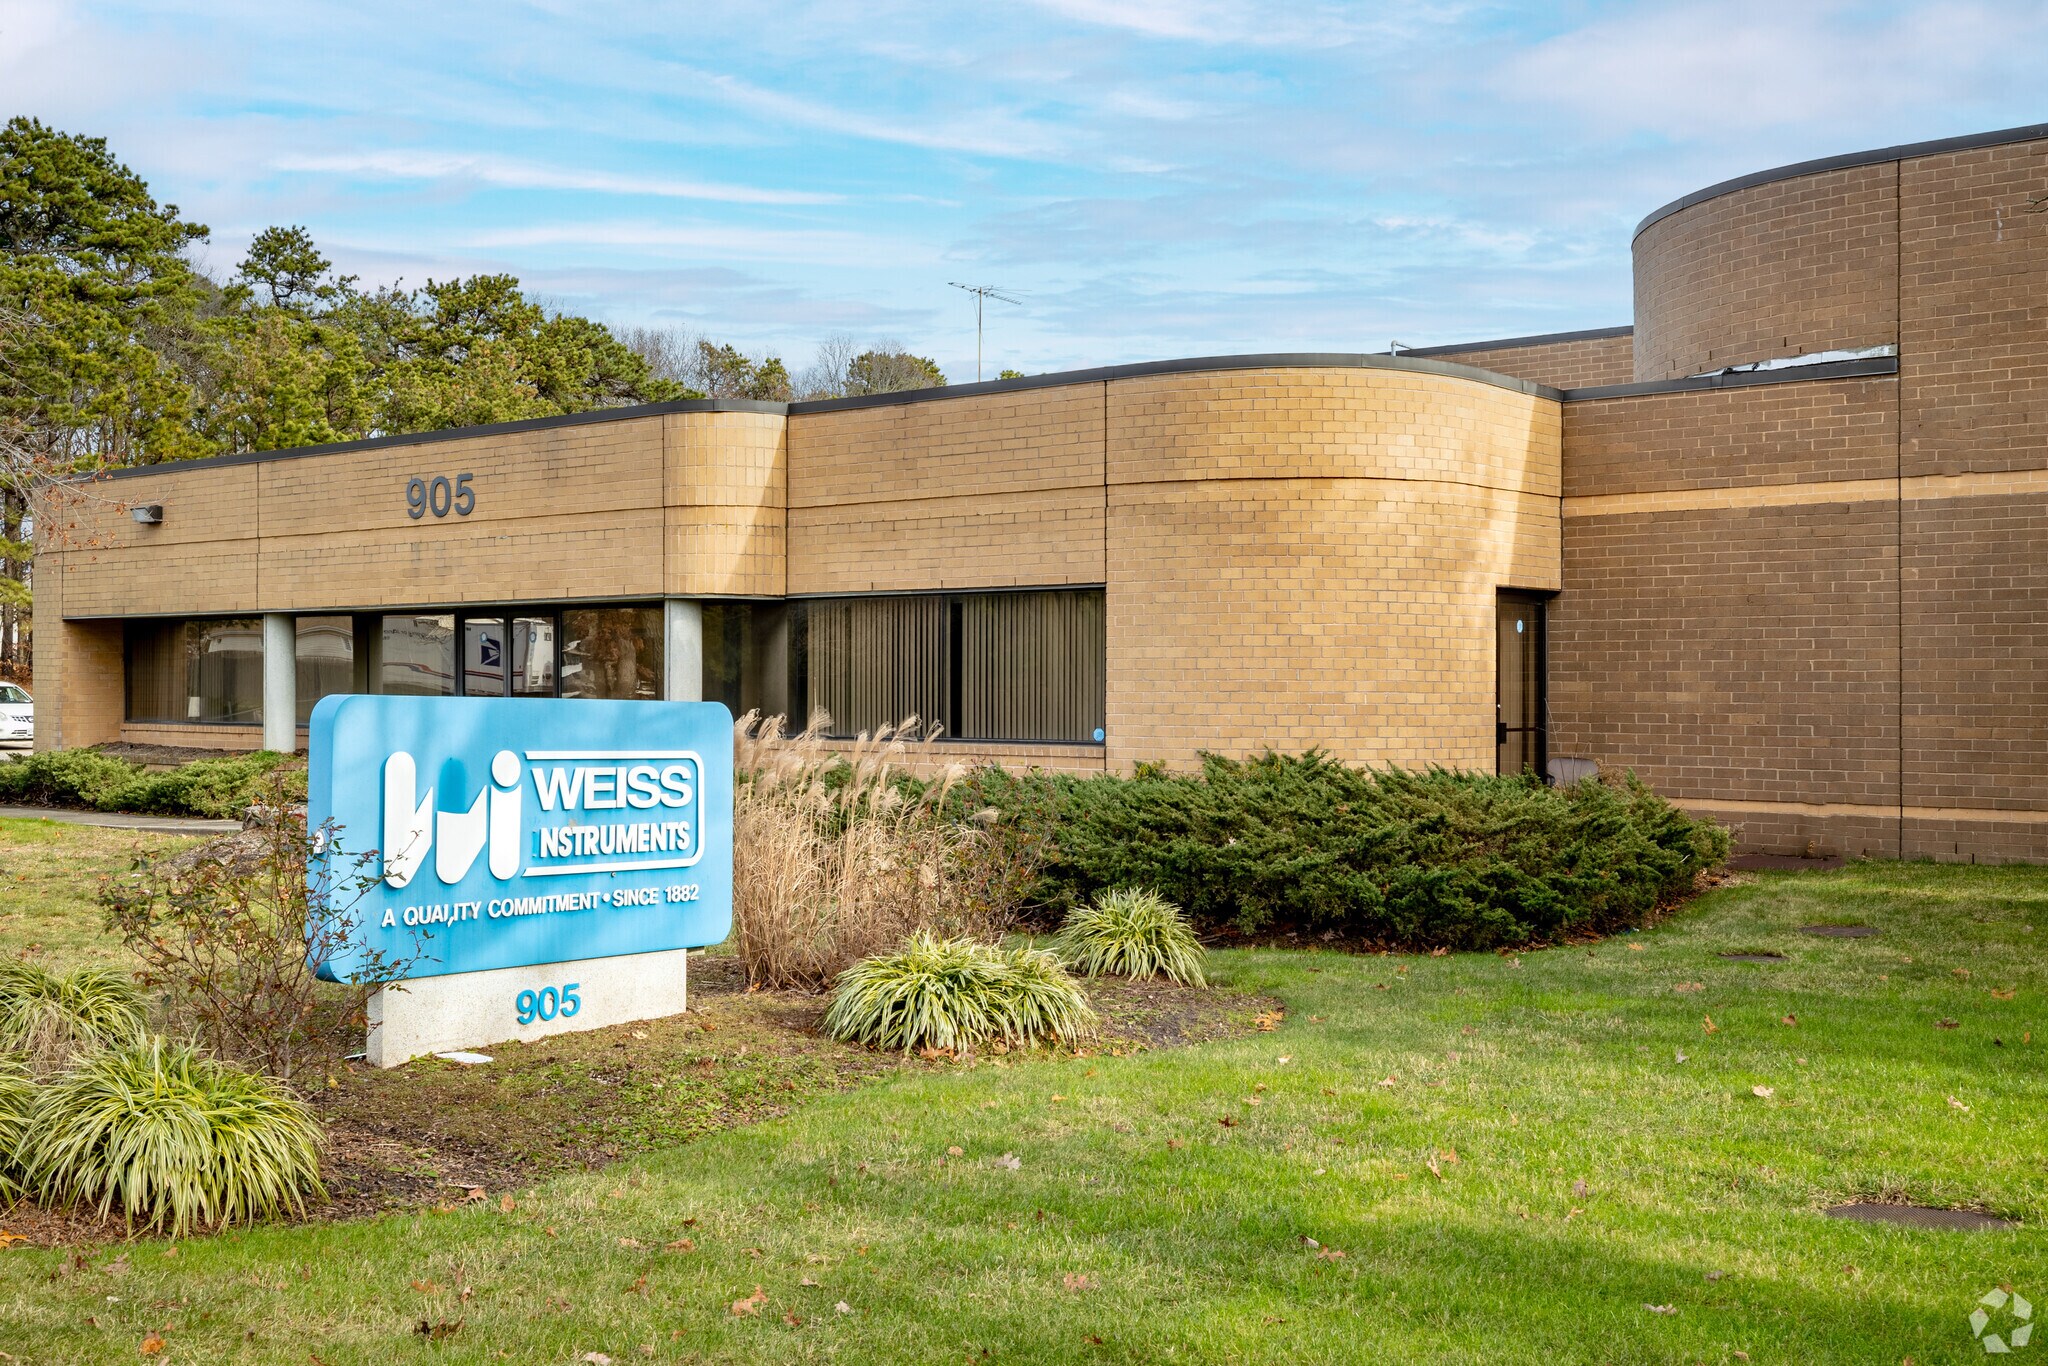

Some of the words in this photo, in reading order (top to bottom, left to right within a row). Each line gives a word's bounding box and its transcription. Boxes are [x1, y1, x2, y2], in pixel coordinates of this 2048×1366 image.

[406, 472, 475, 520] 905
[531, 765, 693, 811] WEISS
[533, 821, 690, 859] NSTRUMENTS
[381, 908, 396, 928] A
[403, 901, 482, 928] QUALITY
[487, 892, 600, 919] COMMITMENT
[612, 887, 659, 907] SINCE
[664, 883, 699, 903] 1882
[516, 982, 582, 1025] 905
